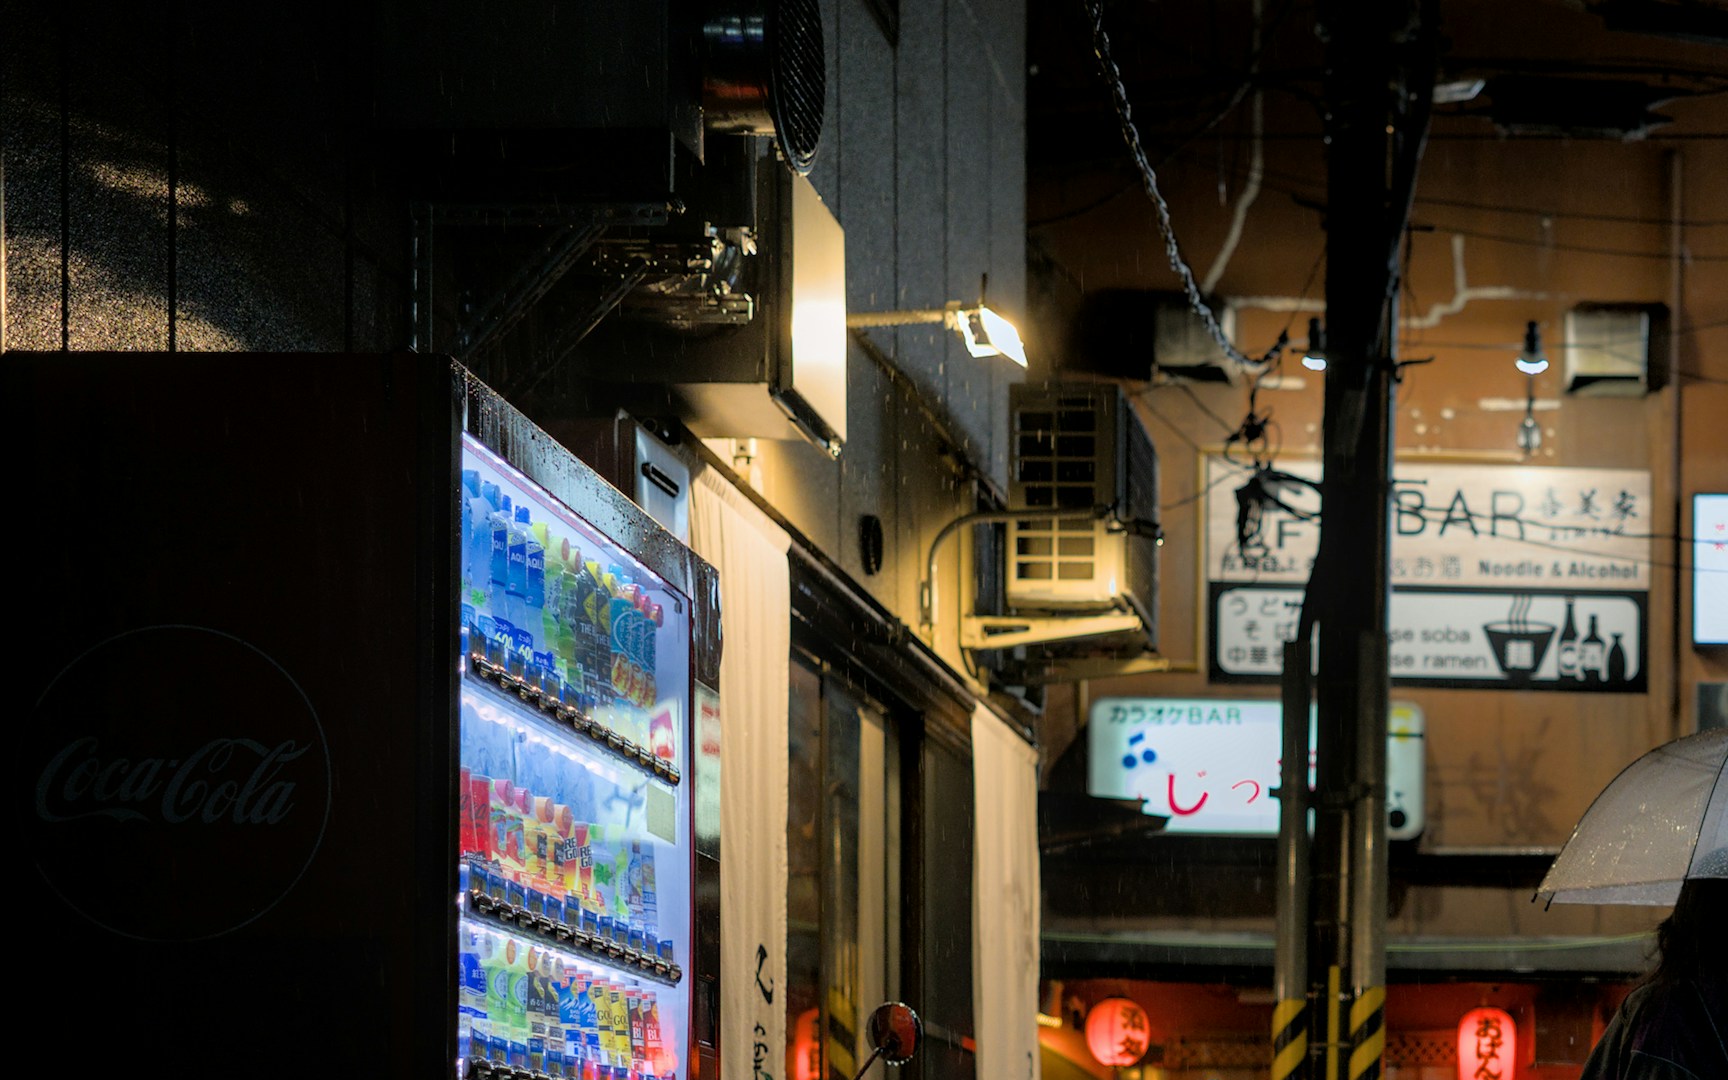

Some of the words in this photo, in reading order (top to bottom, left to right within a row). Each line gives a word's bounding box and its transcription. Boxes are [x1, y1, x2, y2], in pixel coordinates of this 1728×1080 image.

[1395, 488, 1525, 540] BAR
[1478, 559, 1544, 578] Noodle
[1551, 560, 1563, 577] &
[1568, 560, 1639, 578] Alcohol
[1421, 625, 1471, 643] soba
[1227, 646, 1284, 665] 中華
[1423, 655, 1488, 668] ramen
[35, 736, 312, 825] Coca-Cola
